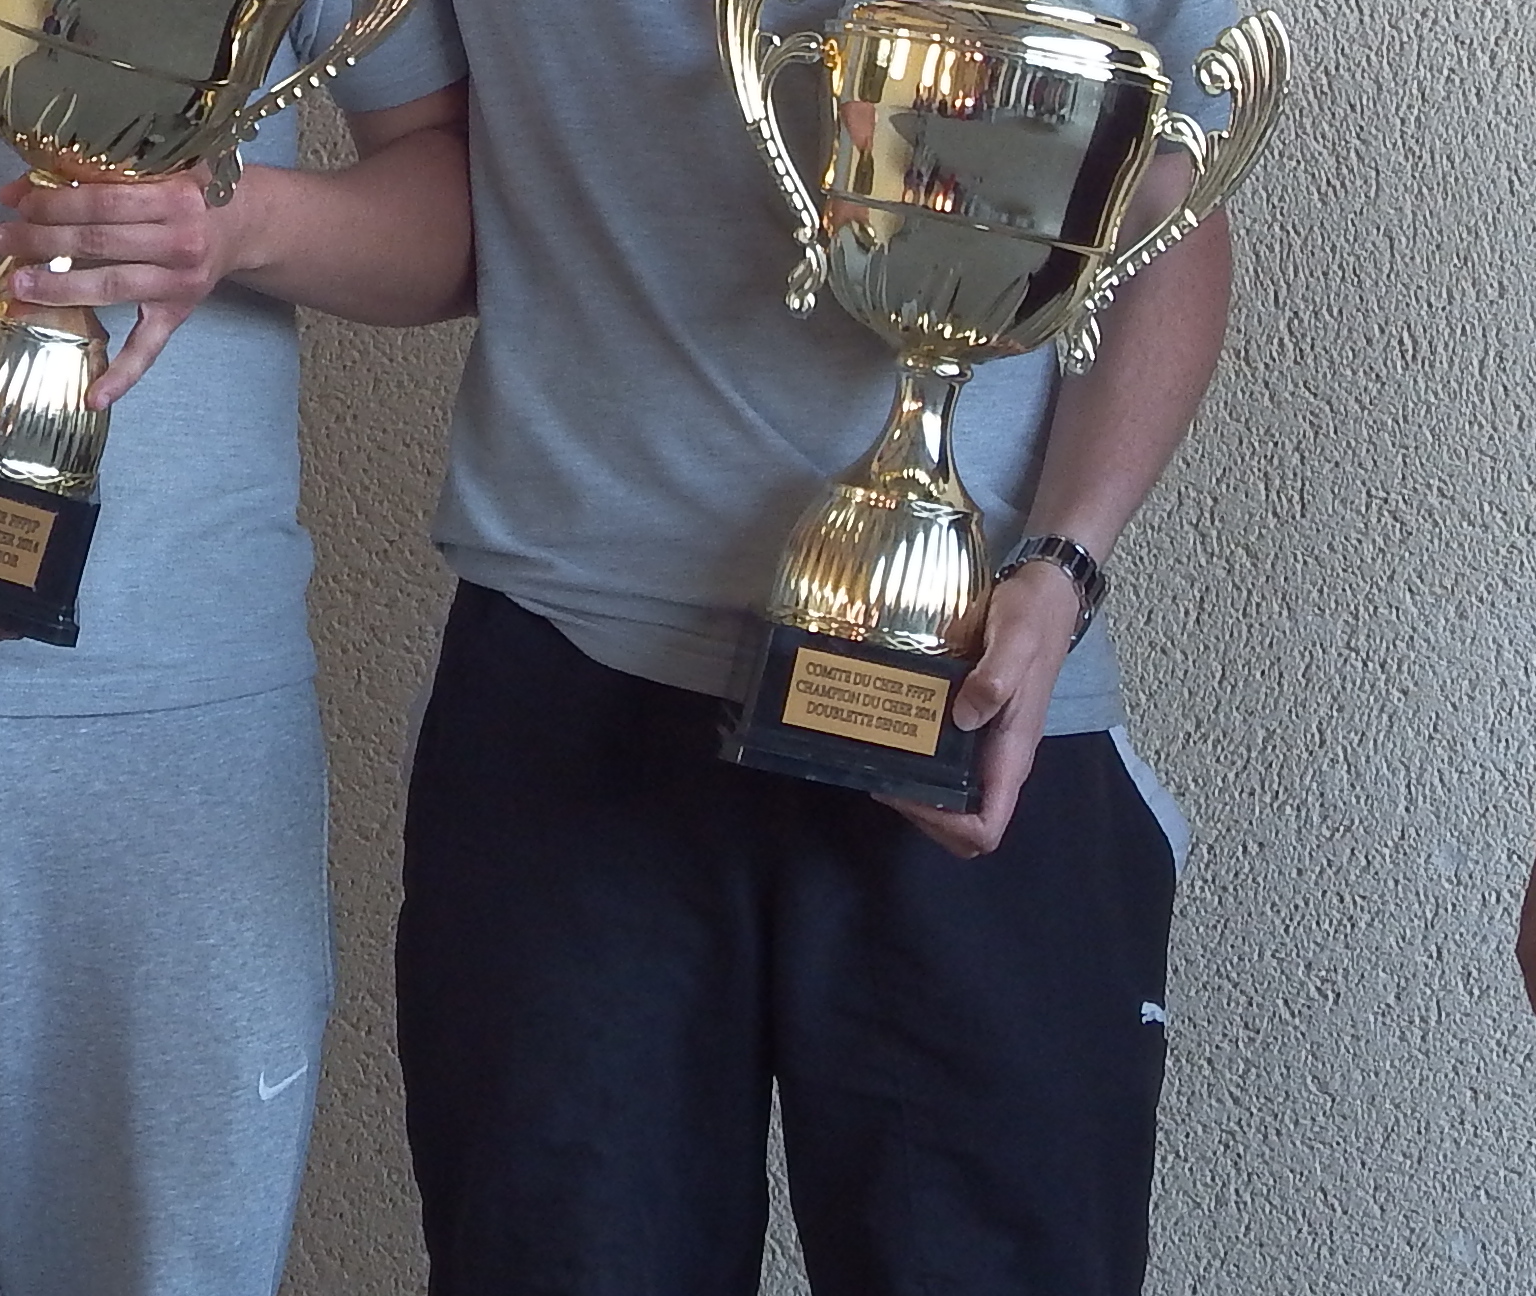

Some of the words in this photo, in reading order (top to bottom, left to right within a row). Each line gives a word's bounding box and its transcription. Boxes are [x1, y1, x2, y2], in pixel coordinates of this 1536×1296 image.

[796, 679, 861, 705] CHAMPION
[862, 693, 881, 710] DU
[882, 698, 913, 717] CHER
[914, 705, 937, 722] 2014
[853, 672, 872, 688] DU
[873, 677, 903, 695] CHER
[806, 701, 874, 728] DOUBLETTE
[875, 716, 918, 737] SENIOR
